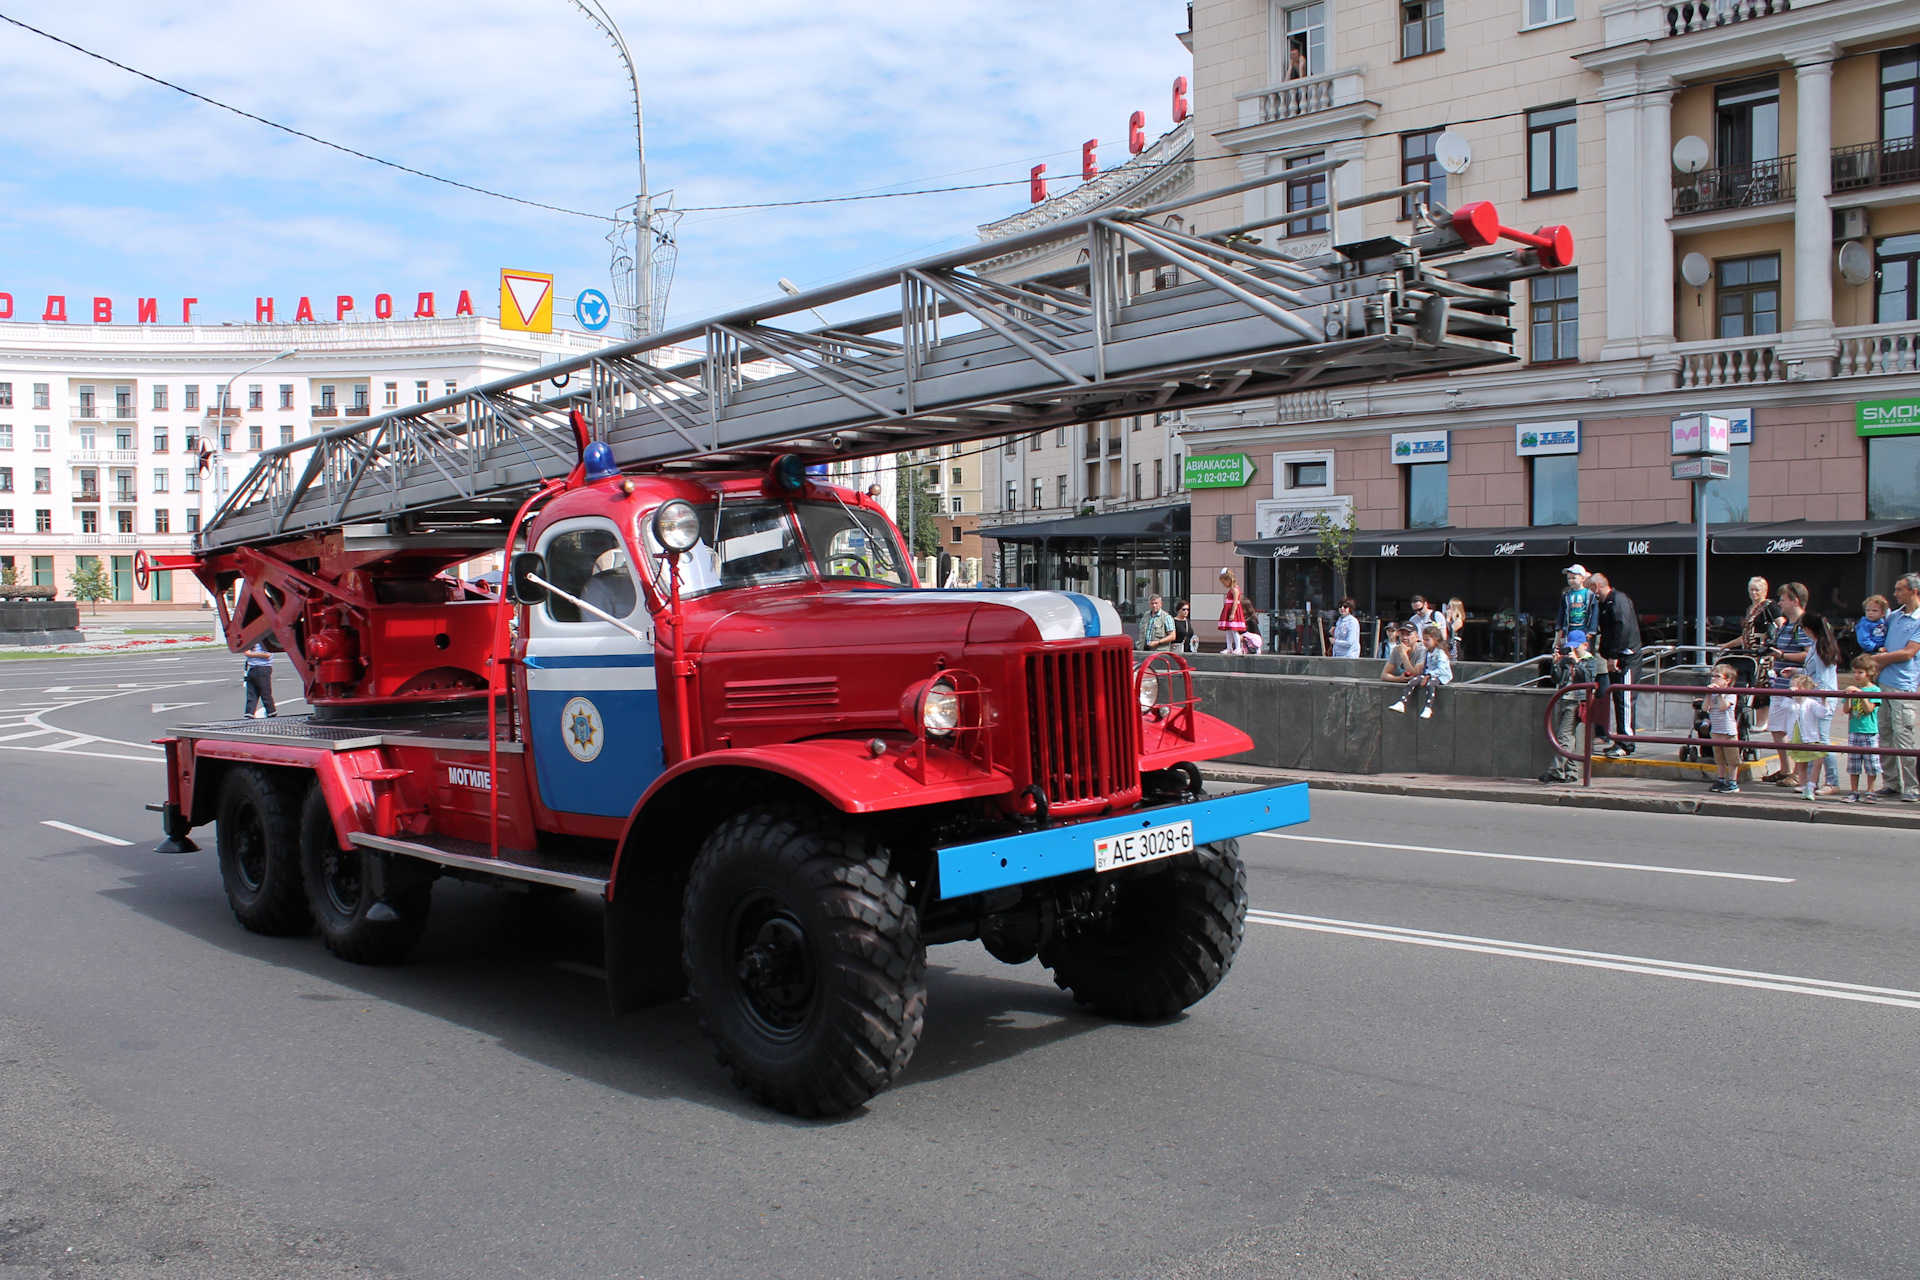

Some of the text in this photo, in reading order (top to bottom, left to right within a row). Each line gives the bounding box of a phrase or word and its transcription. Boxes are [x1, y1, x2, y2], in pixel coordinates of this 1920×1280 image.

[256, 290, 474, 322] НАРОДА
[1540, 430, 1576, 440] TEZ
[1412, 440, 1445, 449] TEZ
[1185, 458, 1240, 472] АВИАКАССЫ
[1197, 473, 1203, 484] 2
[1204, 471, 1240, 483] 02-02-02
[1380, 544, 1400, 557] КАФЕ
[1627, 541, 1650, 555] КАФЕ
[448, 766, 498, 790] МОГИЛЕ
[1139, 826, 1190, 858] 3028-6
[1098, 857, 1107, 868] BY
